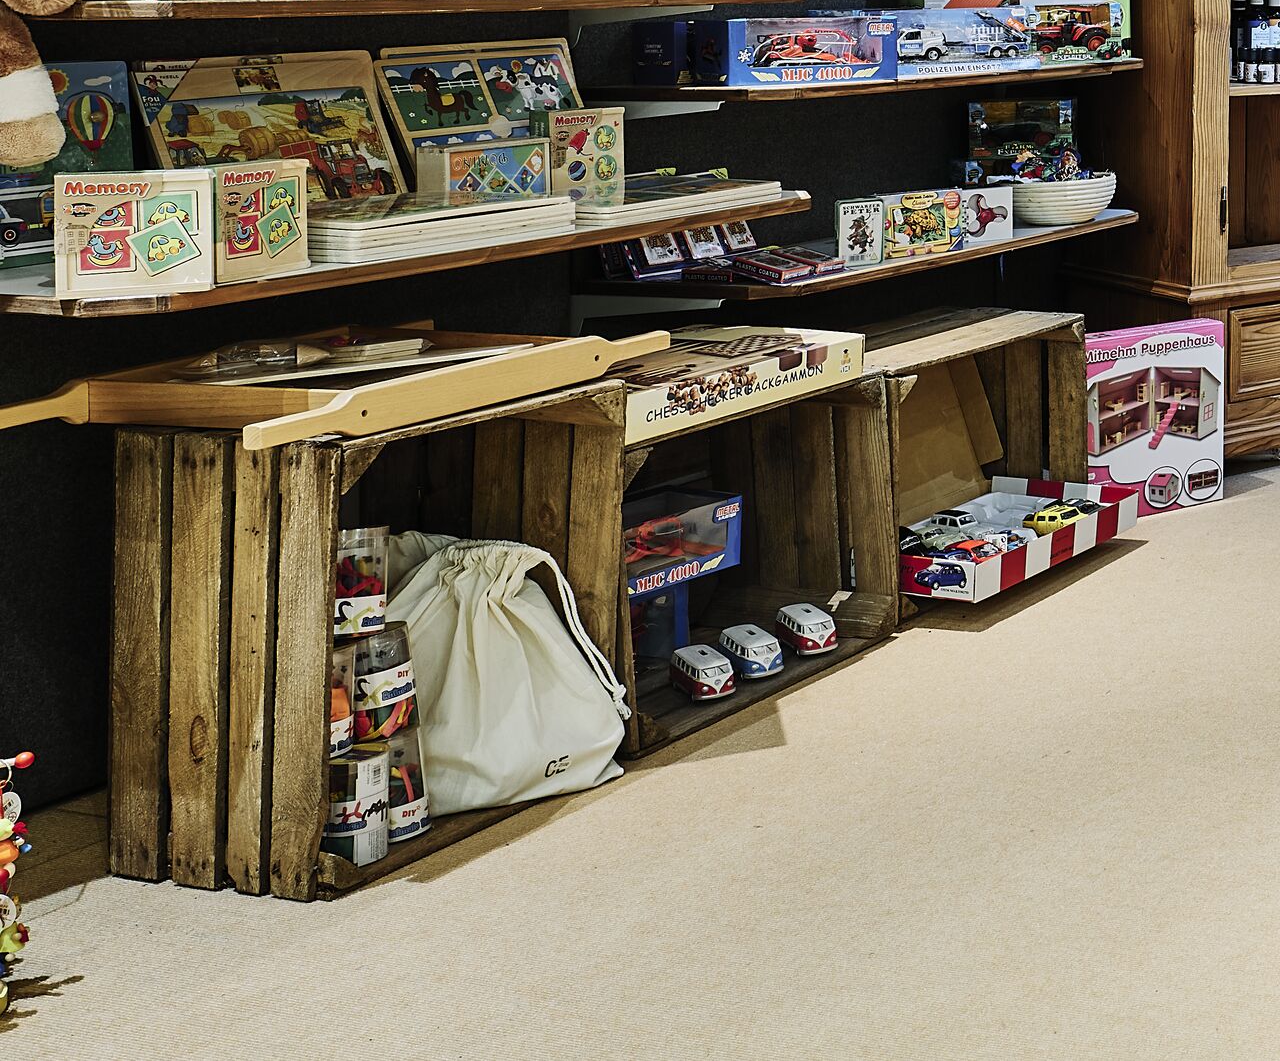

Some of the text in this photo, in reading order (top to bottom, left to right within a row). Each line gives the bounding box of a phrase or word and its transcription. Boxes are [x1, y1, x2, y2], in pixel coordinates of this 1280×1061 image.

[868, 23, 894, 31] METAL
[781, 67, 853, 82] MJC 4000
[918, 66, 952, 74] POLIZEI
[555, 113, 597, 126] Memory
[223, 170, 276, 186] Memory
[64, 181, 150, 197] Memory
[843, 207, 880, 215] PETER
[685, 273, 705, 281] PLASTIC
[736, 261, 757, 272] PLASTIC
[758, 268, 779, 279] COATED
[1141, 334, 1216, 356] Puppenhaus
[646, 364, 823, 422] CHESS CHECKER BACKGAMMON
[636, 561, 700, 593] MJC 4000
